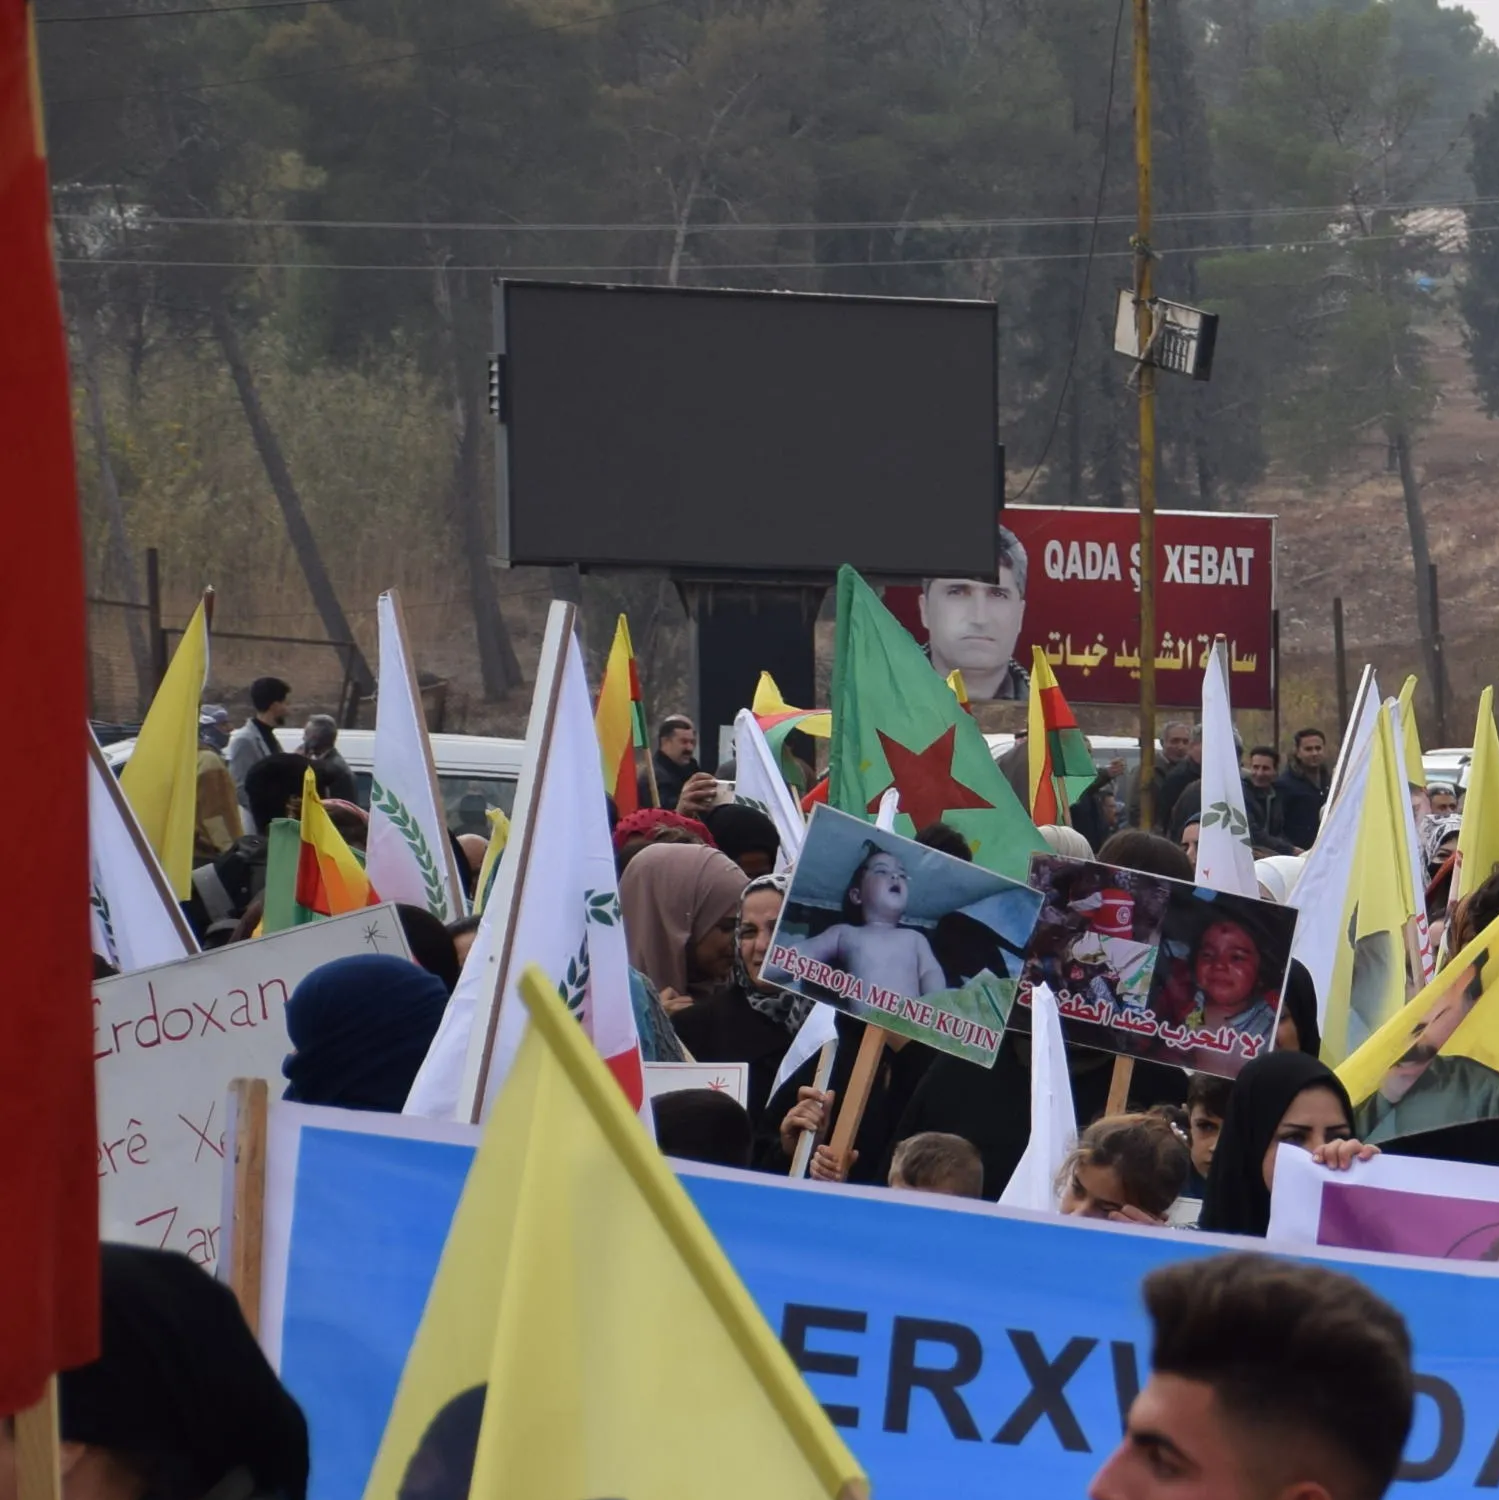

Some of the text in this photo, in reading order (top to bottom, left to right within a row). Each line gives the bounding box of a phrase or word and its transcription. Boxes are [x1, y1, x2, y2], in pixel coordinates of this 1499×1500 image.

[1044, 540, 1122, 582] QADA
[1163, 545, 1254, 586] XEBAT
[1113, 631, 1193, 680] الشيد
[1198, 633, 1257, 673] ساة
[770, 945, 1001, 1051] PÊŞEROJA ME NE KUJIN
[1111, 1008, 1157, 1037] ضد
[1159, 1020, 1236, 1054] للحرب
[1240, 1031, 1265, 1058] لا
